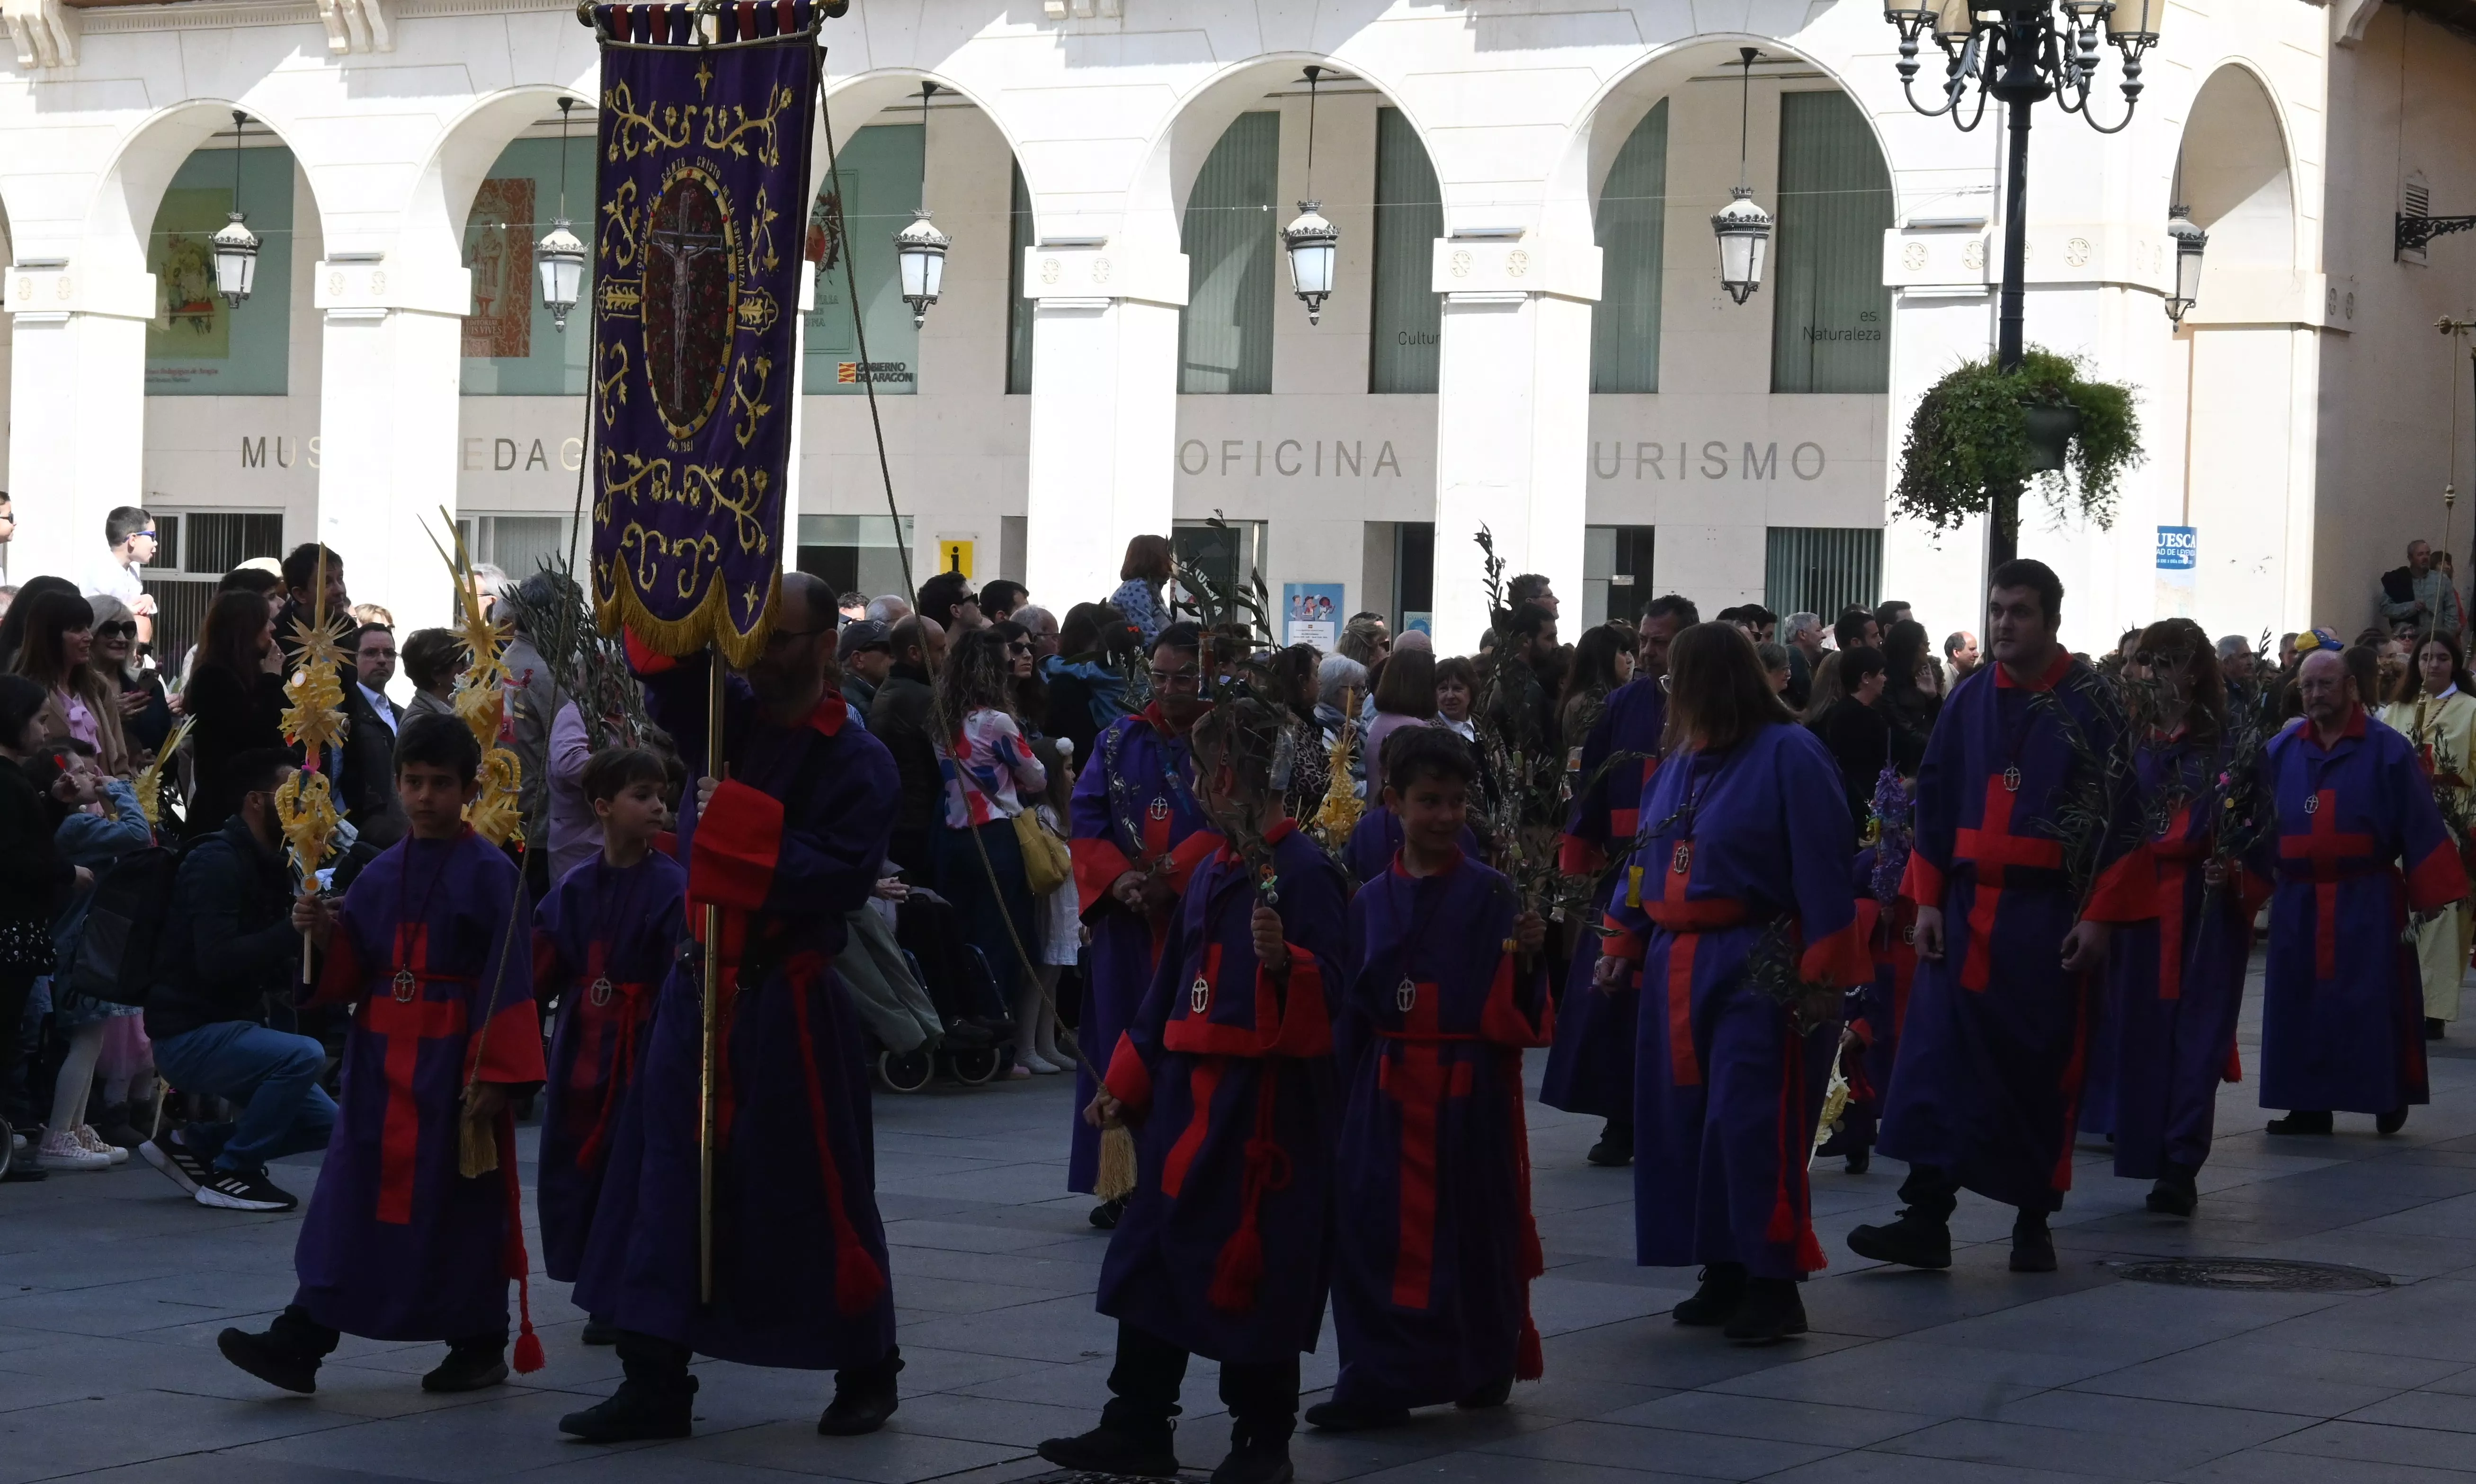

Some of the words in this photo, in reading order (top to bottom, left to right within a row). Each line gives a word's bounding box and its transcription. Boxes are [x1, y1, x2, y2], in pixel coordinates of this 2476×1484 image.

[646, 192, 656, 213] DEL
[661, 157, 686, 182] SANTO
[696, 155, 721, 180] CRISTO
[722, 184, 730, 199] DE
[727, 198, 735, 216] LA
[732, 220, 746, 287] ESPERANZA
[1860, 311, 1881, 322] es.
[479, 325, 502, 334] VIVES
[1803, 326, 1881, 341] Naturaleza
[857, 362, 906, 372] GBIERNO
[1179, 439, 1402, 477] OFICINA
[1594, 440, 1826, 480] URISMO
